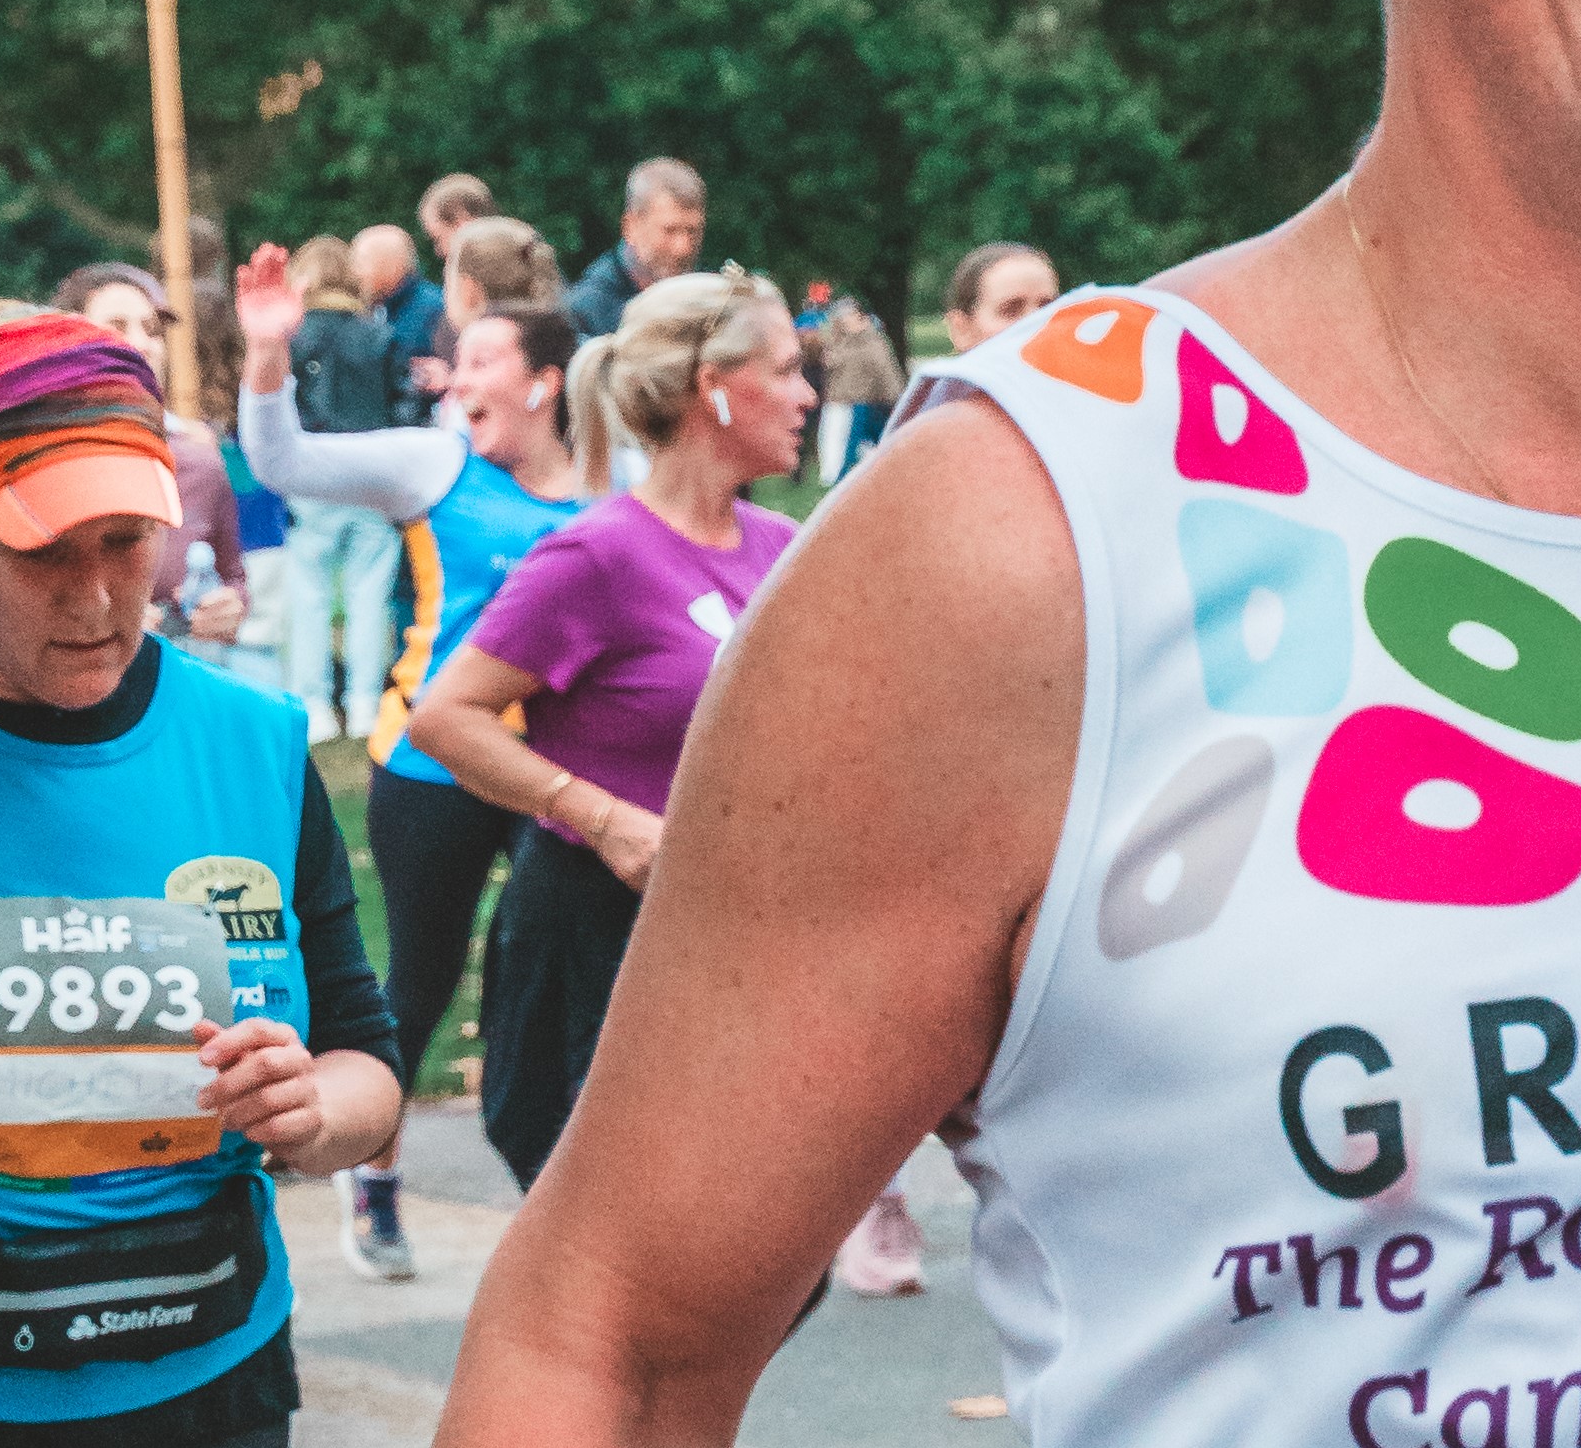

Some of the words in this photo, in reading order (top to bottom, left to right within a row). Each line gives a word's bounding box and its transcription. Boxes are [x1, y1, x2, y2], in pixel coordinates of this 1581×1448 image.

[21, 915, 132, 953] Half
[221, 913, 279, 940] IRY
[1212, 1232, 1435, 1323] The
